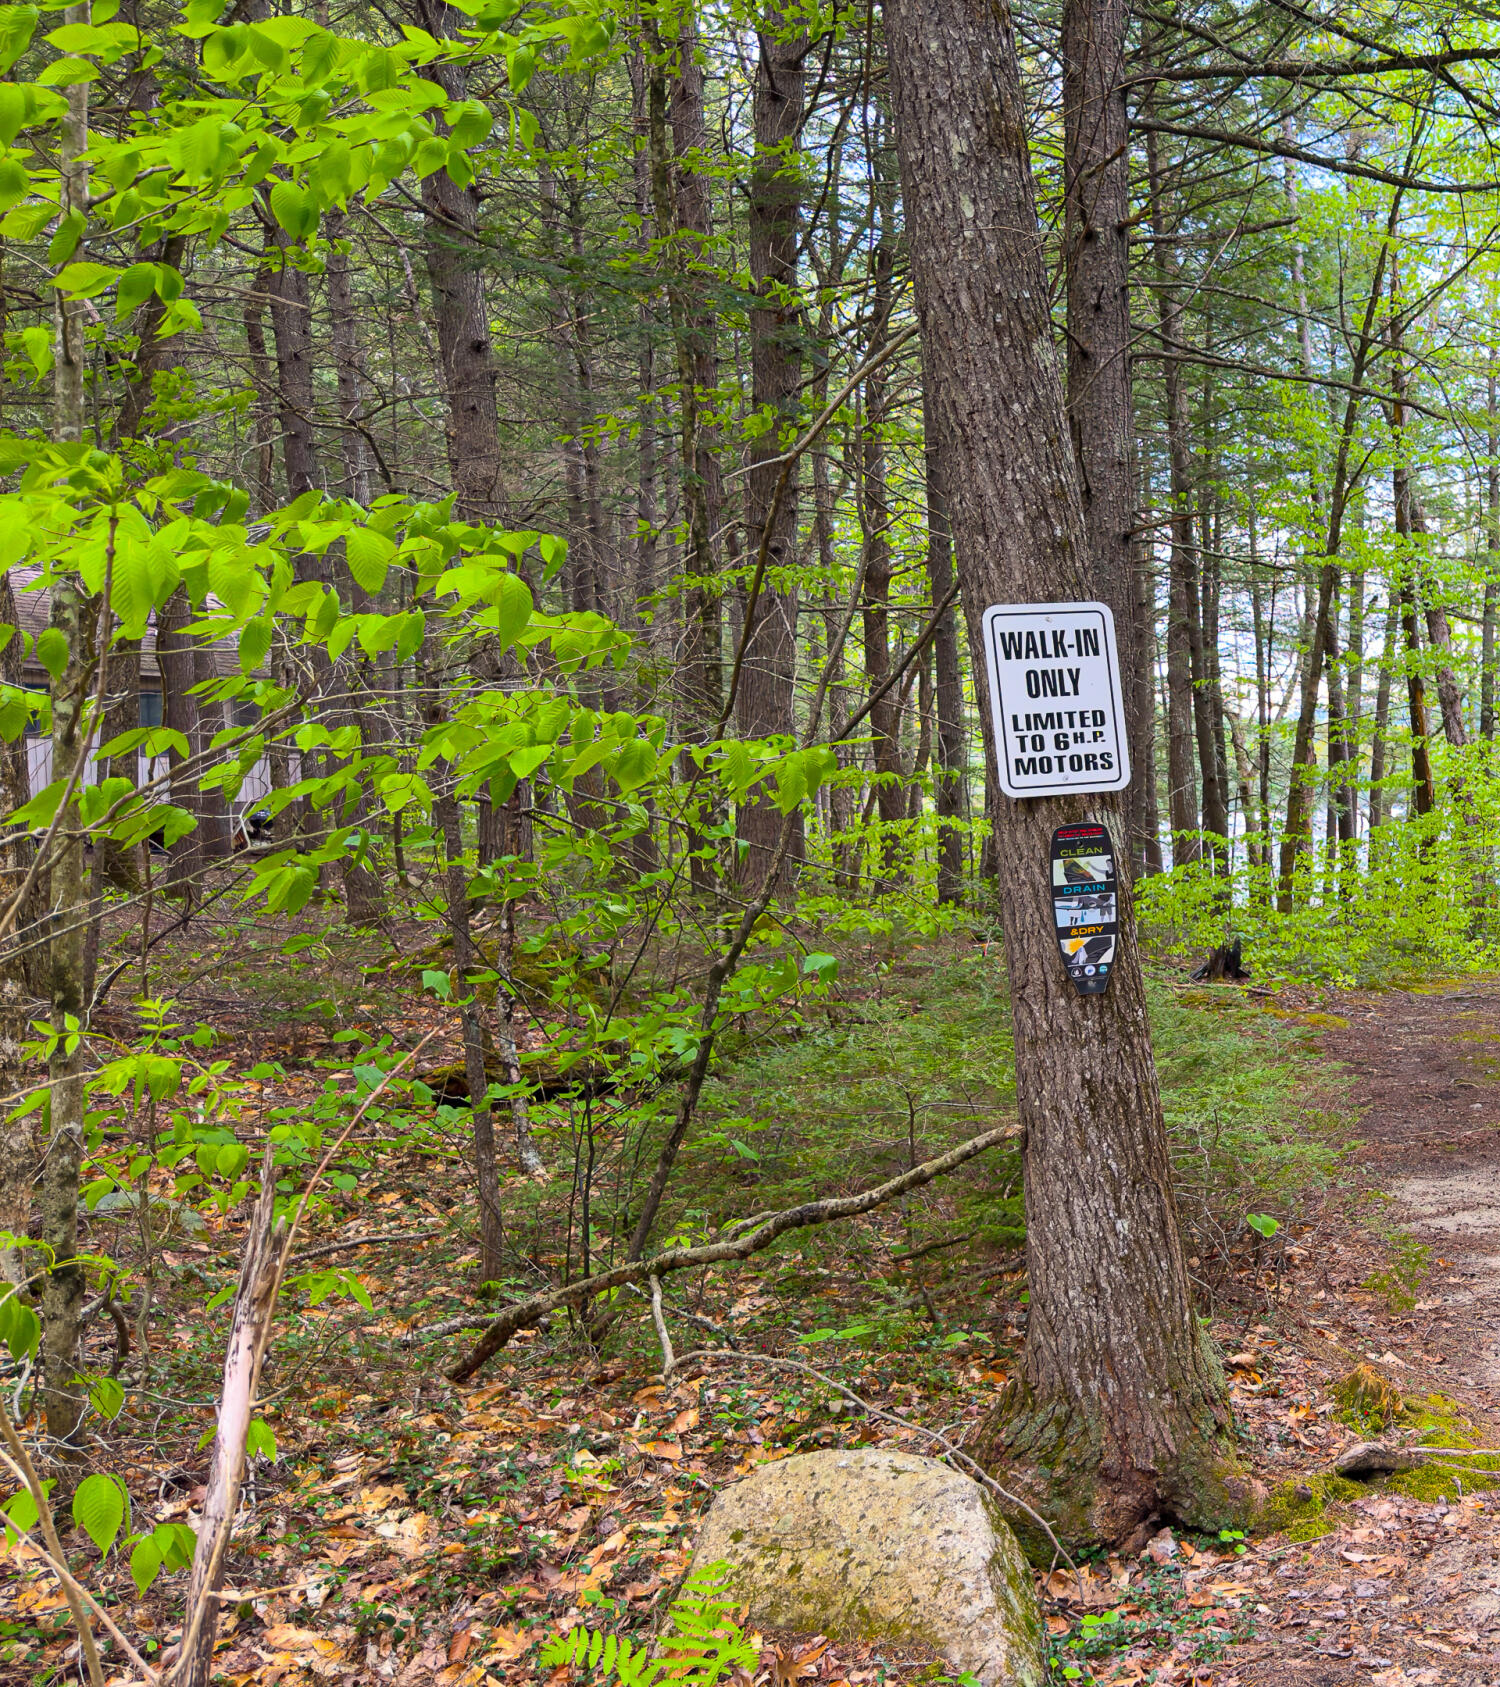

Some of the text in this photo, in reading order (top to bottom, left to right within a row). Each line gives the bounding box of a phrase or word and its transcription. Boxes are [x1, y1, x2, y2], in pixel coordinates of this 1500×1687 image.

[999, 628, 1100, 660] WALK-IN
[1025, 667, 1081, 698] ONLY
[1011, 709, 1106, 732] LIMITED
[1015, 733, 1045, 753] TO
[1014, 751, 1114, 776] MOTORS
[1060, 846, 1103, 857] CLEAN
[1063, 883, 1106, 895] DRAIN
